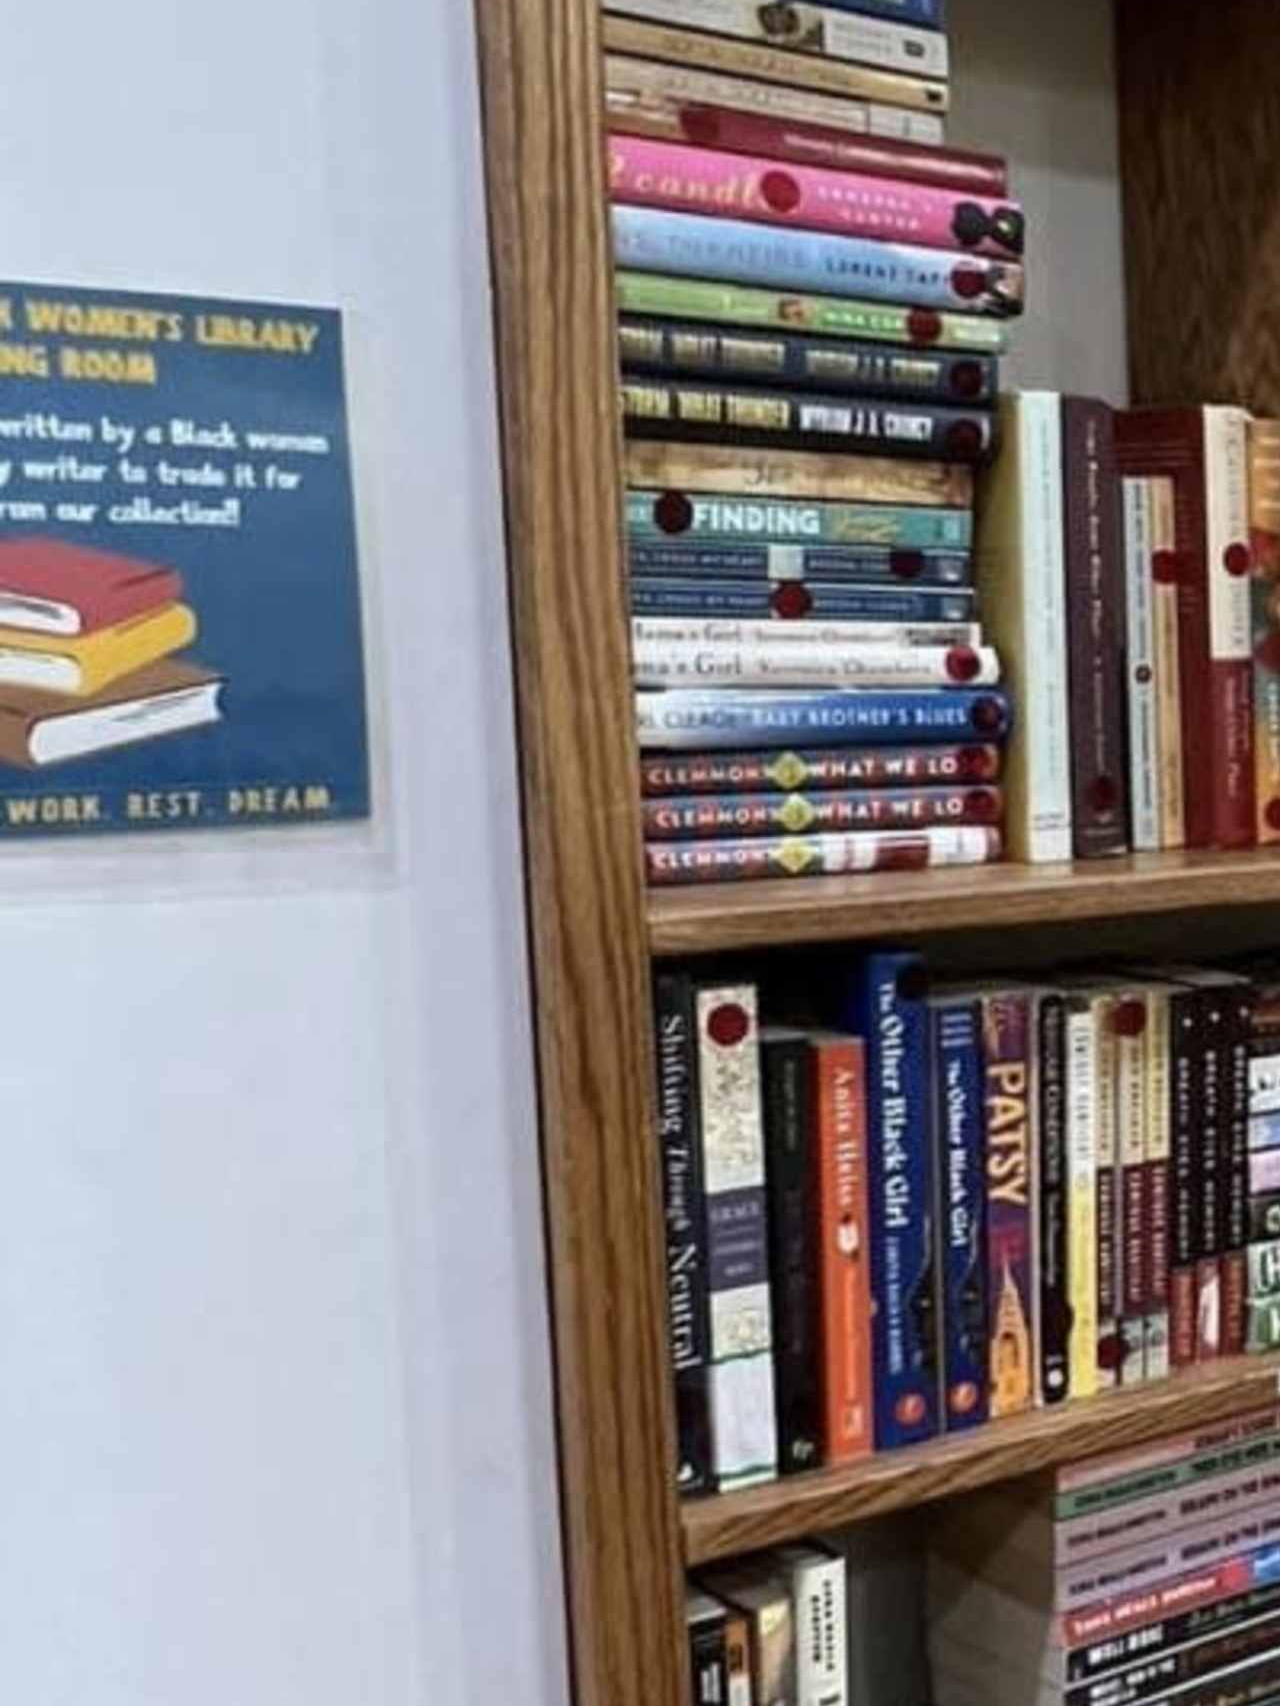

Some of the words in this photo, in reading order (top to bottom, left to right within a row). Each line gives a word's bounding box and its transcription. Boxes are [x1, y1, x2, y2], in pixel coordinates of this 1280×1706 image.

[25, 299, 183, 343] WOMEN'S
[195, 315, 320, 355] LIBRARY
[59, 349, 156, 385] ROOM
[101, 417, 136, 453] by
[146, 426, 163, 445] a
[170, 419, 238, 447] Black
[246, 431, 330, 454] woman
[24, 457, 107, 482] writer
[118, 458, 148, 484] to
[157, 462, 226, 488] trade
[234, 463, 256, 490] it
[265, 468, 302, 492] for
[0, 501, 47, 521] rom
[56, 503, 97, 523] our
[695, 501, 821, 538] FINDING
[647, 763, 774, 786] CLEMMON
[811, 757, 876, 779] WHAT
[882, 756, 919, 777] WE
[928, 756, 958, 776] LO
[228, 785, 330, 814] DREAM
[654, 806, 778, 830] CLEMMON
[815, 799, 879, 820] WHAT
[887, 797, 921, 819] WE
[932, 796, 965, 817] LO
[651, 847, 772, 872] CLEMMON
[880, 981, 896, 1013] The
[879, 1015, 906, 1091] Other
[946, 1060, 961, 1085] The
[660, 1014, 685, 1136] Shifting
[834, 1068, 857, 1133] Anita
[948, 1086, 966, 1144] Other
[884, 1095, 909, 1171] Black
[986, 1061, 1028, 1207] PATSY
[949, 1149, 968, 1205] Black
[886, 1176, 912, 1228] Girl
[951, 1207, 970, 1249] Girl
[669, 1241, 699, 1371] Neutral
